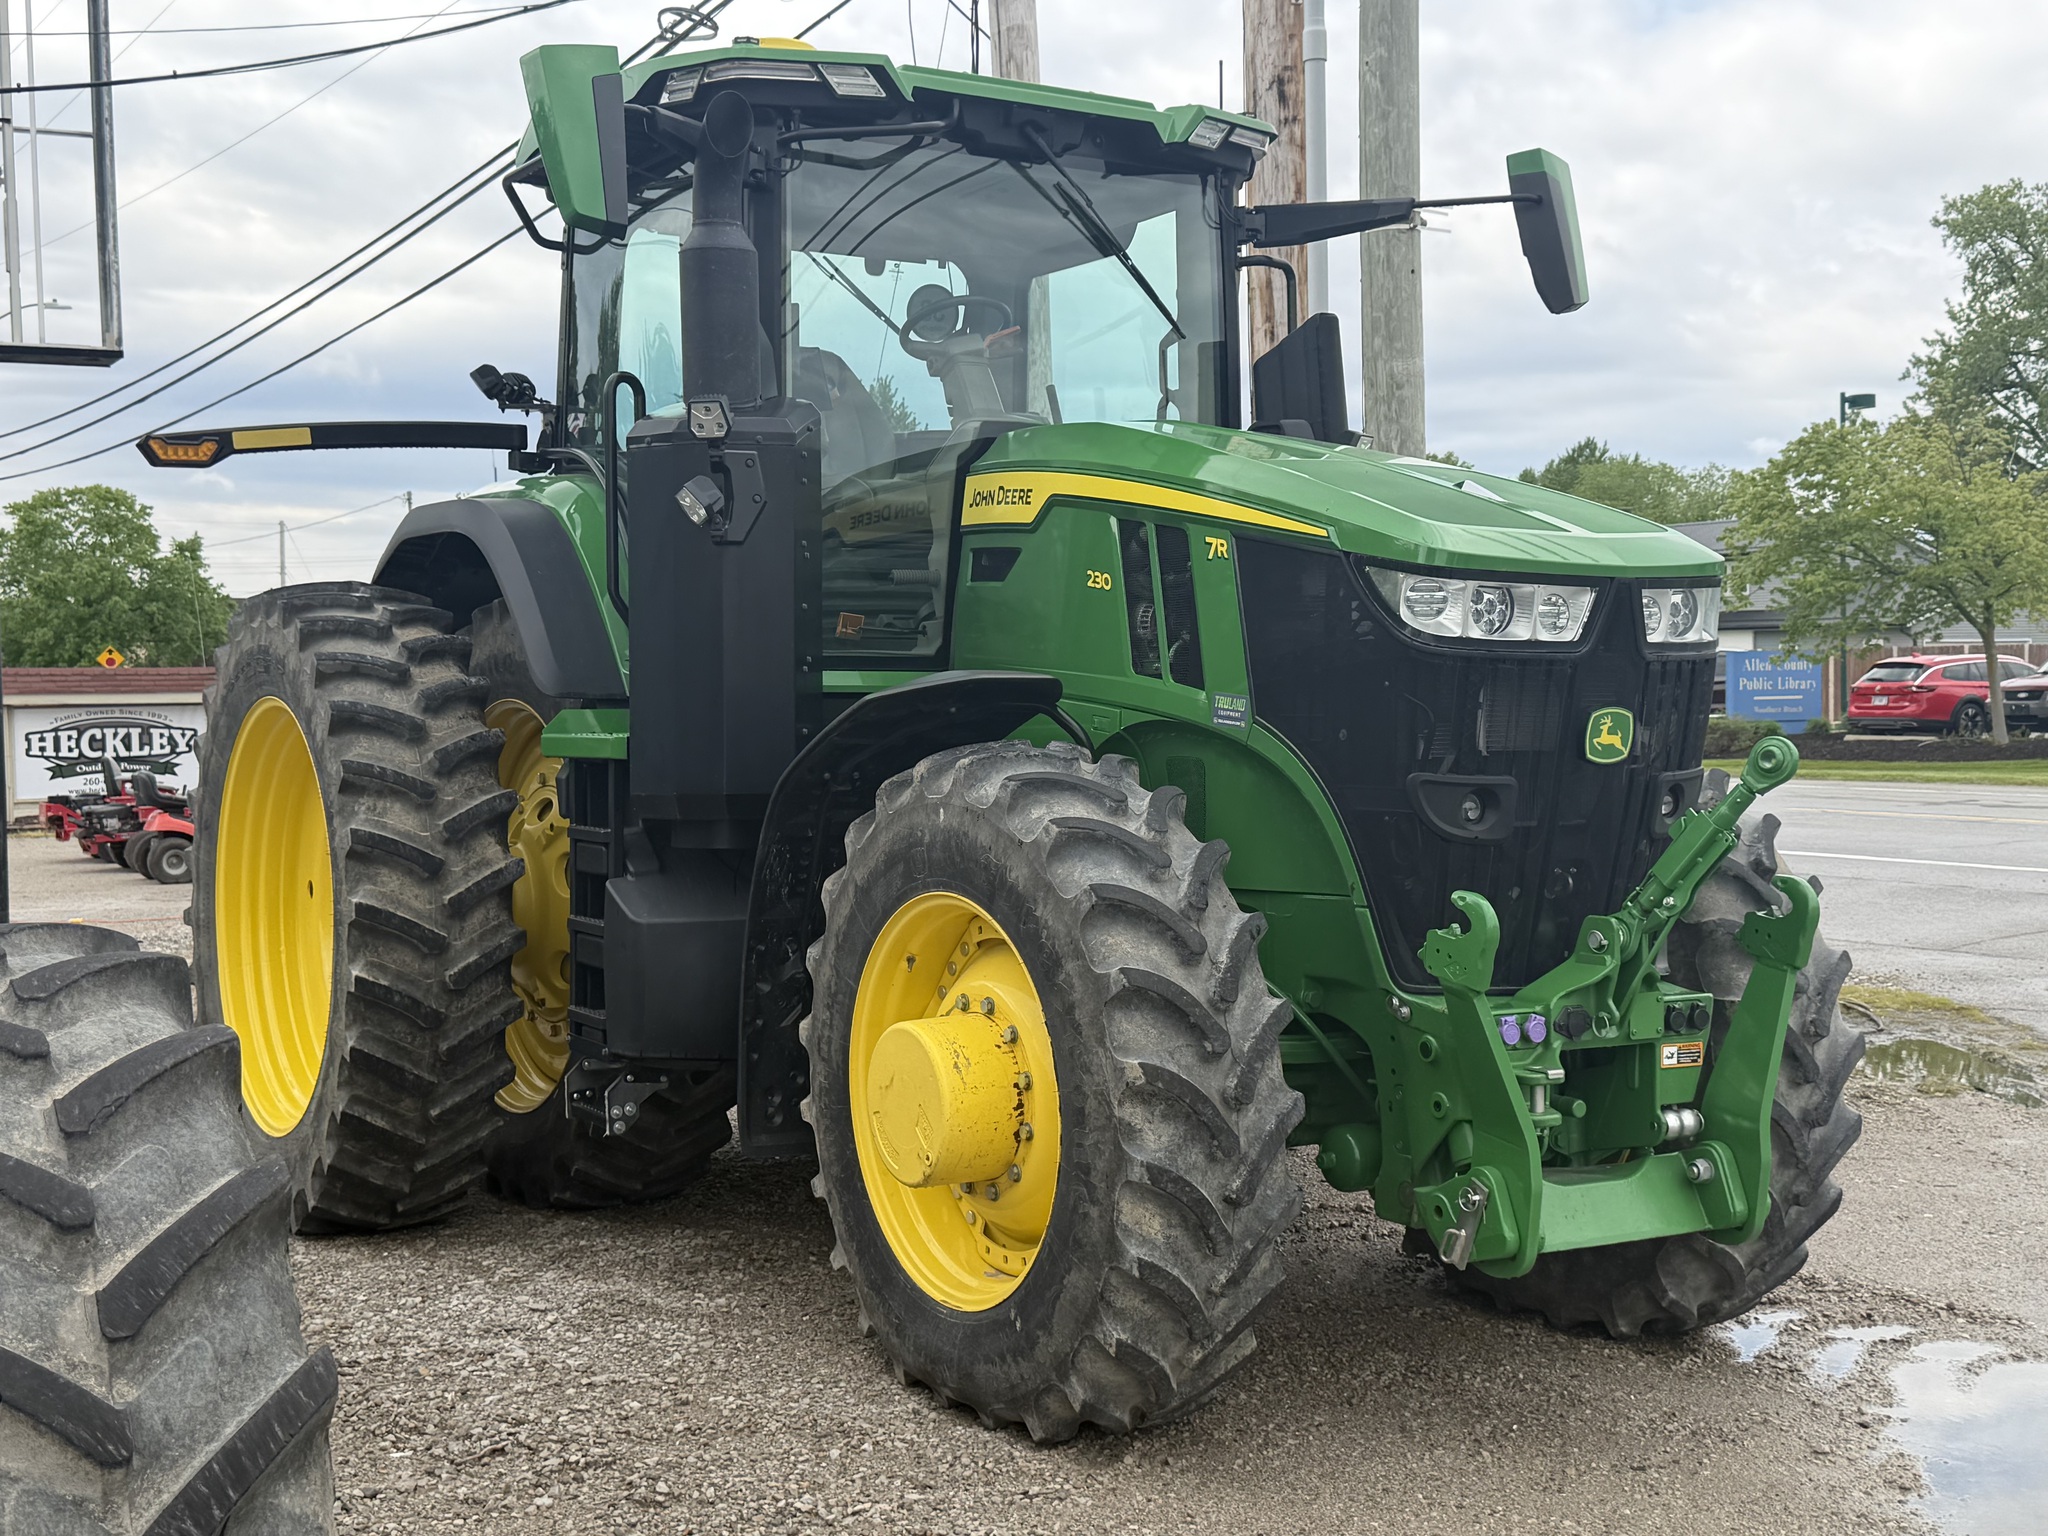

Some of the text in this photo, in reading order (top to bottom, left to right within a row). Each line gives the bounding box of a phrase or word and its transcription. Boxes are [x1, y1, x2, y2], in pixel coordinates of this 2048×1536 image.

[969, 485, 1033, 508] JOHN DEERE
[1205, 536, 1229, 560] 7R
[1086, 569, 1112, 591] 230
[1743, 658, 1772, 672] Allen
[1739, 676, 1816, 692] Public Library
[1215, 695, 1246, 711] TRULAND
[86, 709, 116, 717] OWNED
[119, 708, 143, 717] SINCE
[27, 726, 197, 759] HECKLEY
[121, 762, 151, 772] Power
